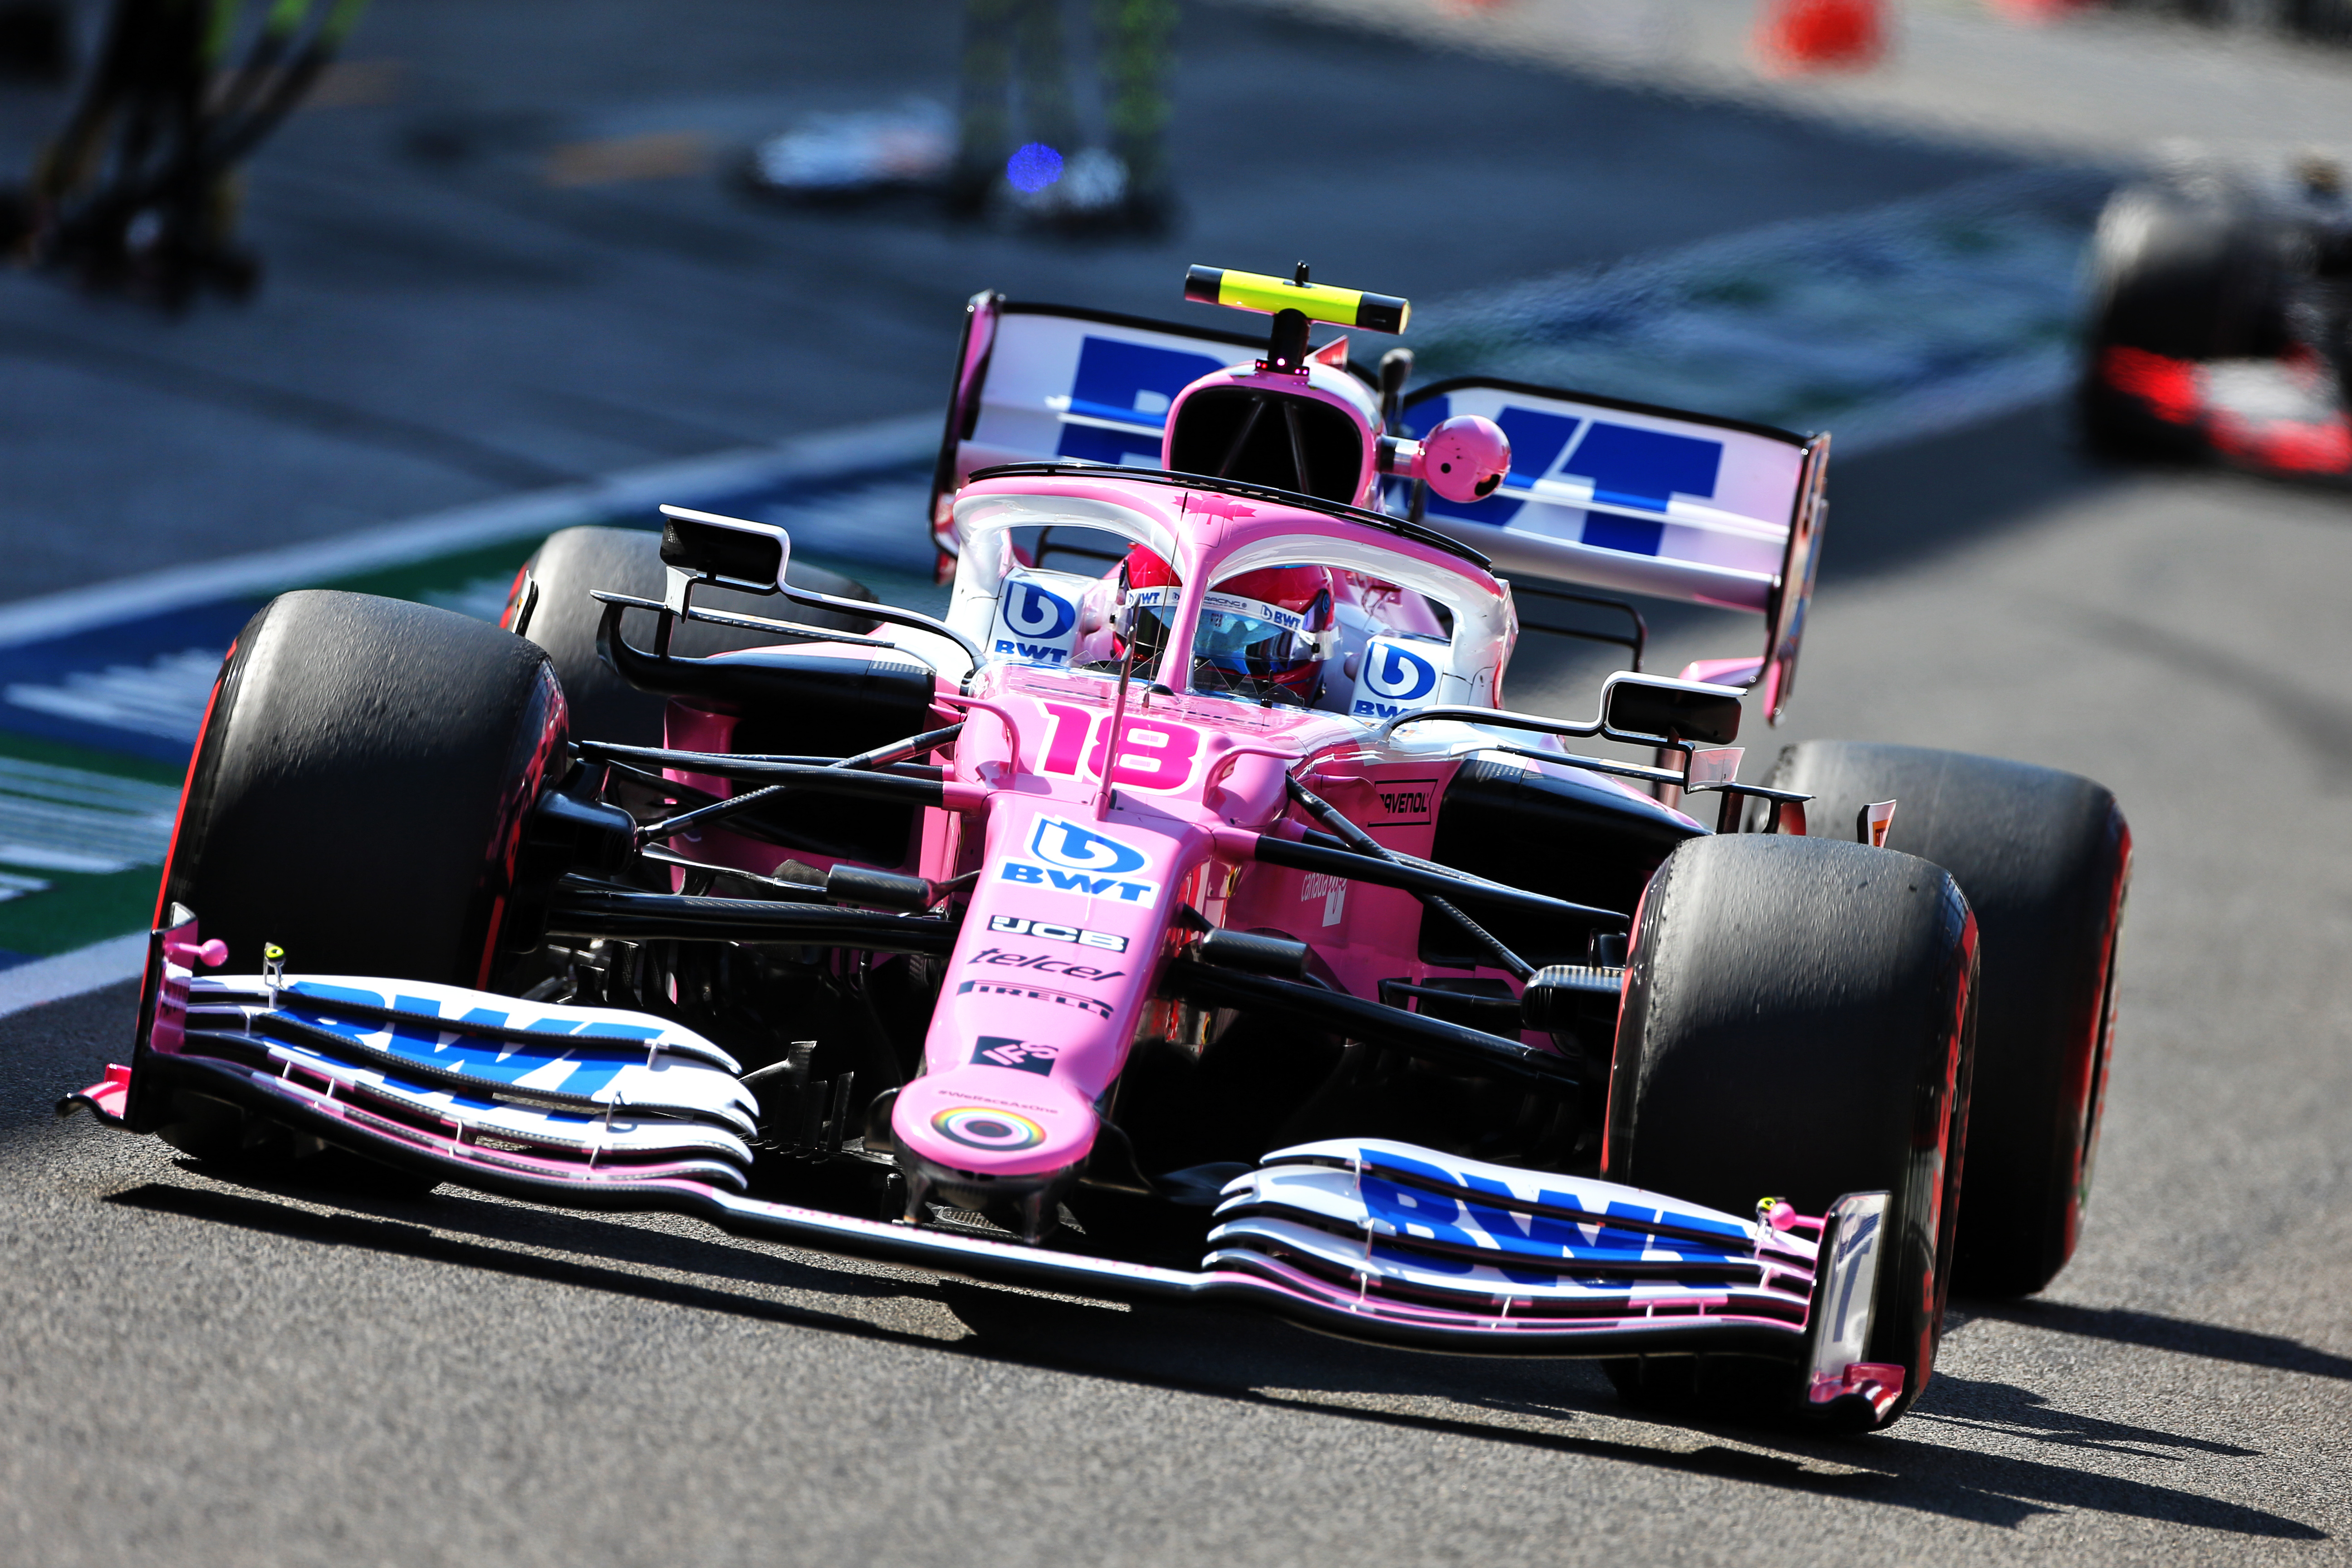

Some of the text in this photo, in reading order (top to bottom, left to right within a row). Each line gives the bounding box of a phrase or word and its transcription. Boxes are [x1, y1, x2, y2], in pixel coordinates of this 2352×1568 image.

[1139, 592, 1160, 604] WT
[1274, 611, 1302, 630] BWT
[995, 639, 1068, 663] BWT
[1353, 699, 1412, 718] BW
[1041, 701, 1203, 791] 18
[1000, 862, 1152, 902] BWT
[991, 916, 1125, 951] JCB
[966, 948, 1126, 981] telcel
[956, 980, 1114, 1020] PIRELLI
